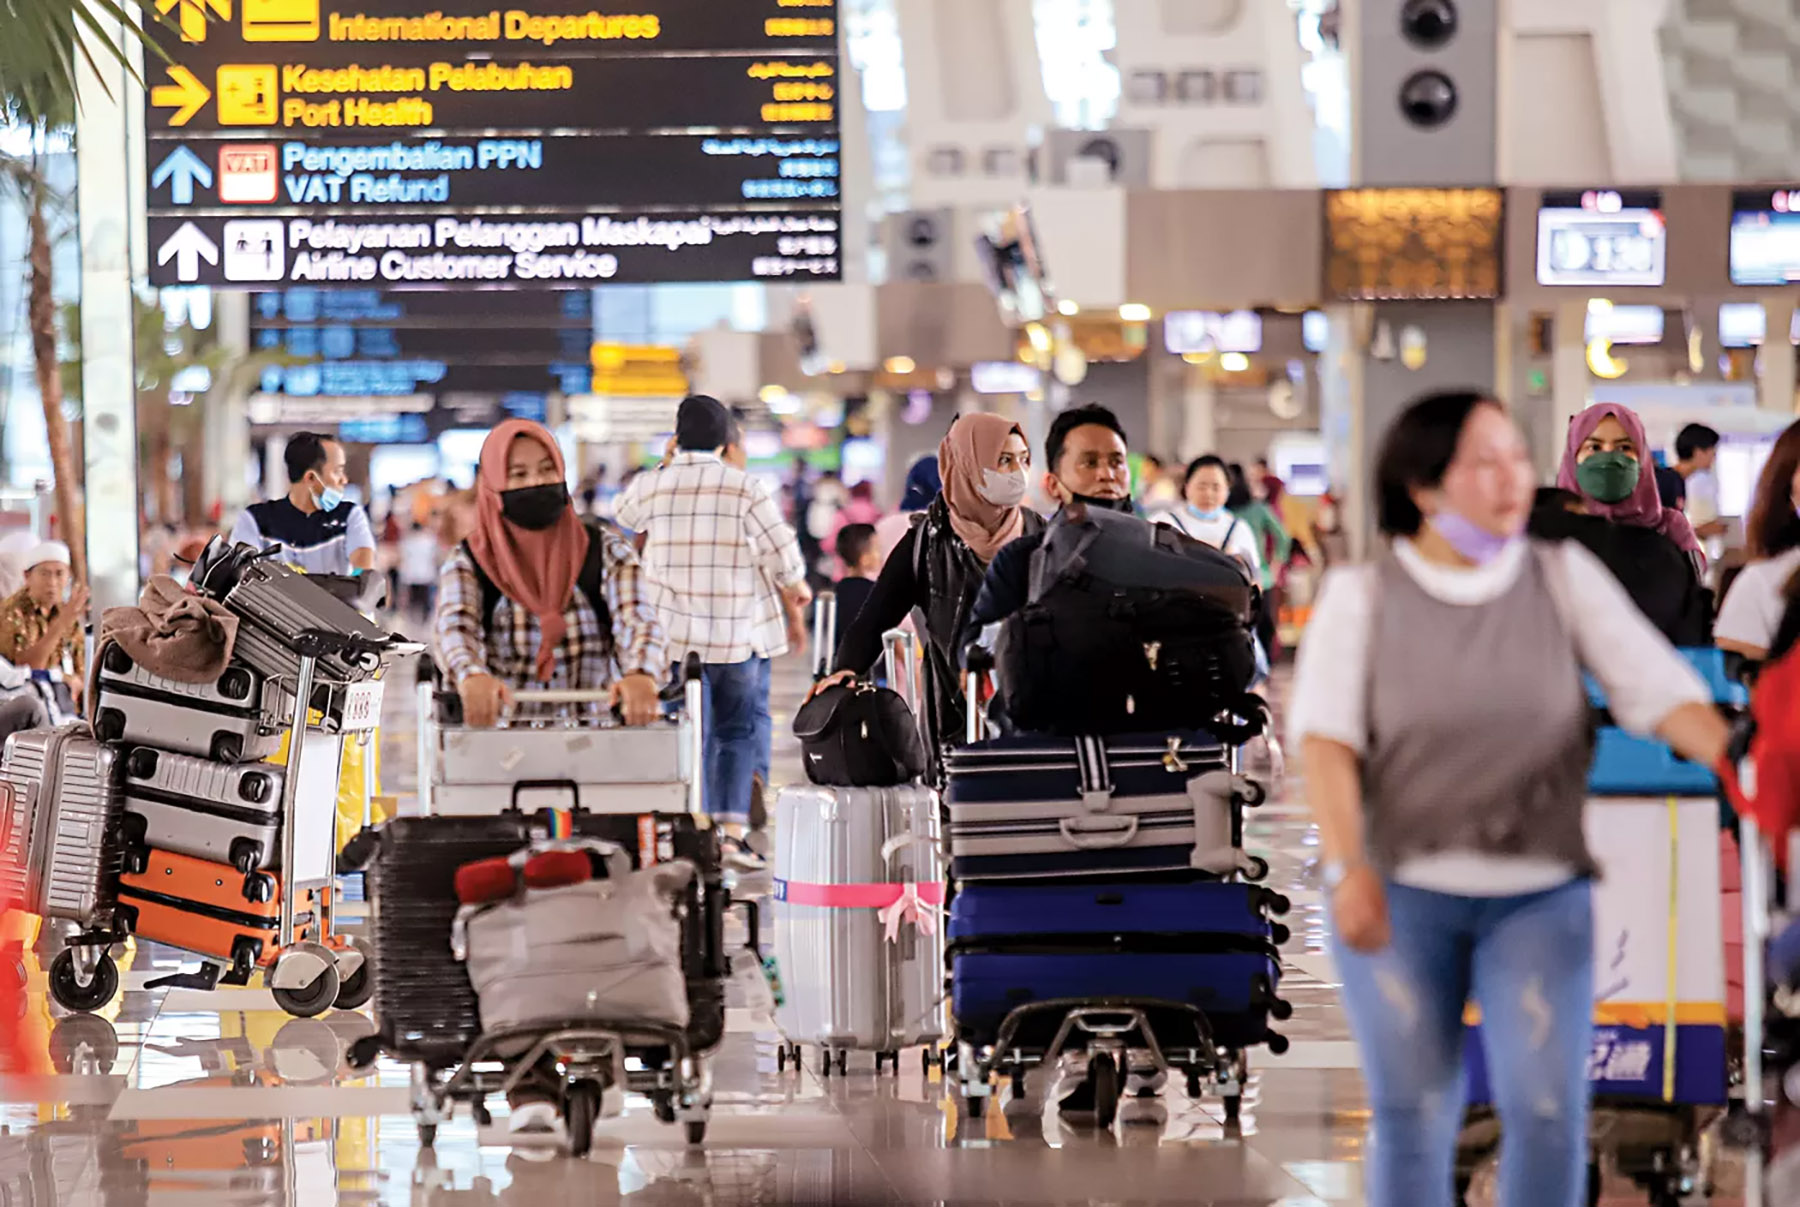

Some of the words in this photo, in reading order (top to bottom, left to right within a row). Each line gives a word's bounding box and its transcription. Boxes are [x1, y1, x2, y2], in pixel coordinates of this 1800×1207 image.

[329, 11, 501, 41] International
[504, 10, 661, 45] Departures
[283, 64, 425, 93] Kesehatan
[429, 62, 573, 91] Pelabuhan
[283, 98, 342, 127] Port
[344, 97, 433, 126] Health
[226, 154, 268, 172] VAT
[283, 141, 474, 177] Pengembalian
[478, 140, 543, 170] PPN
[284, 174, 347, 203] VAT
[350, 174, 450, 203] Refund
[289, 218, 431, 254] Pelayanan
[435, 217, 579, 252] Pelanggan
[582, 216, 712, 251] Maskapai
[291, 251, 377, 280] Airline
[380, 250, 513, 280] Customer
[514, 249, 618, 279] Service
